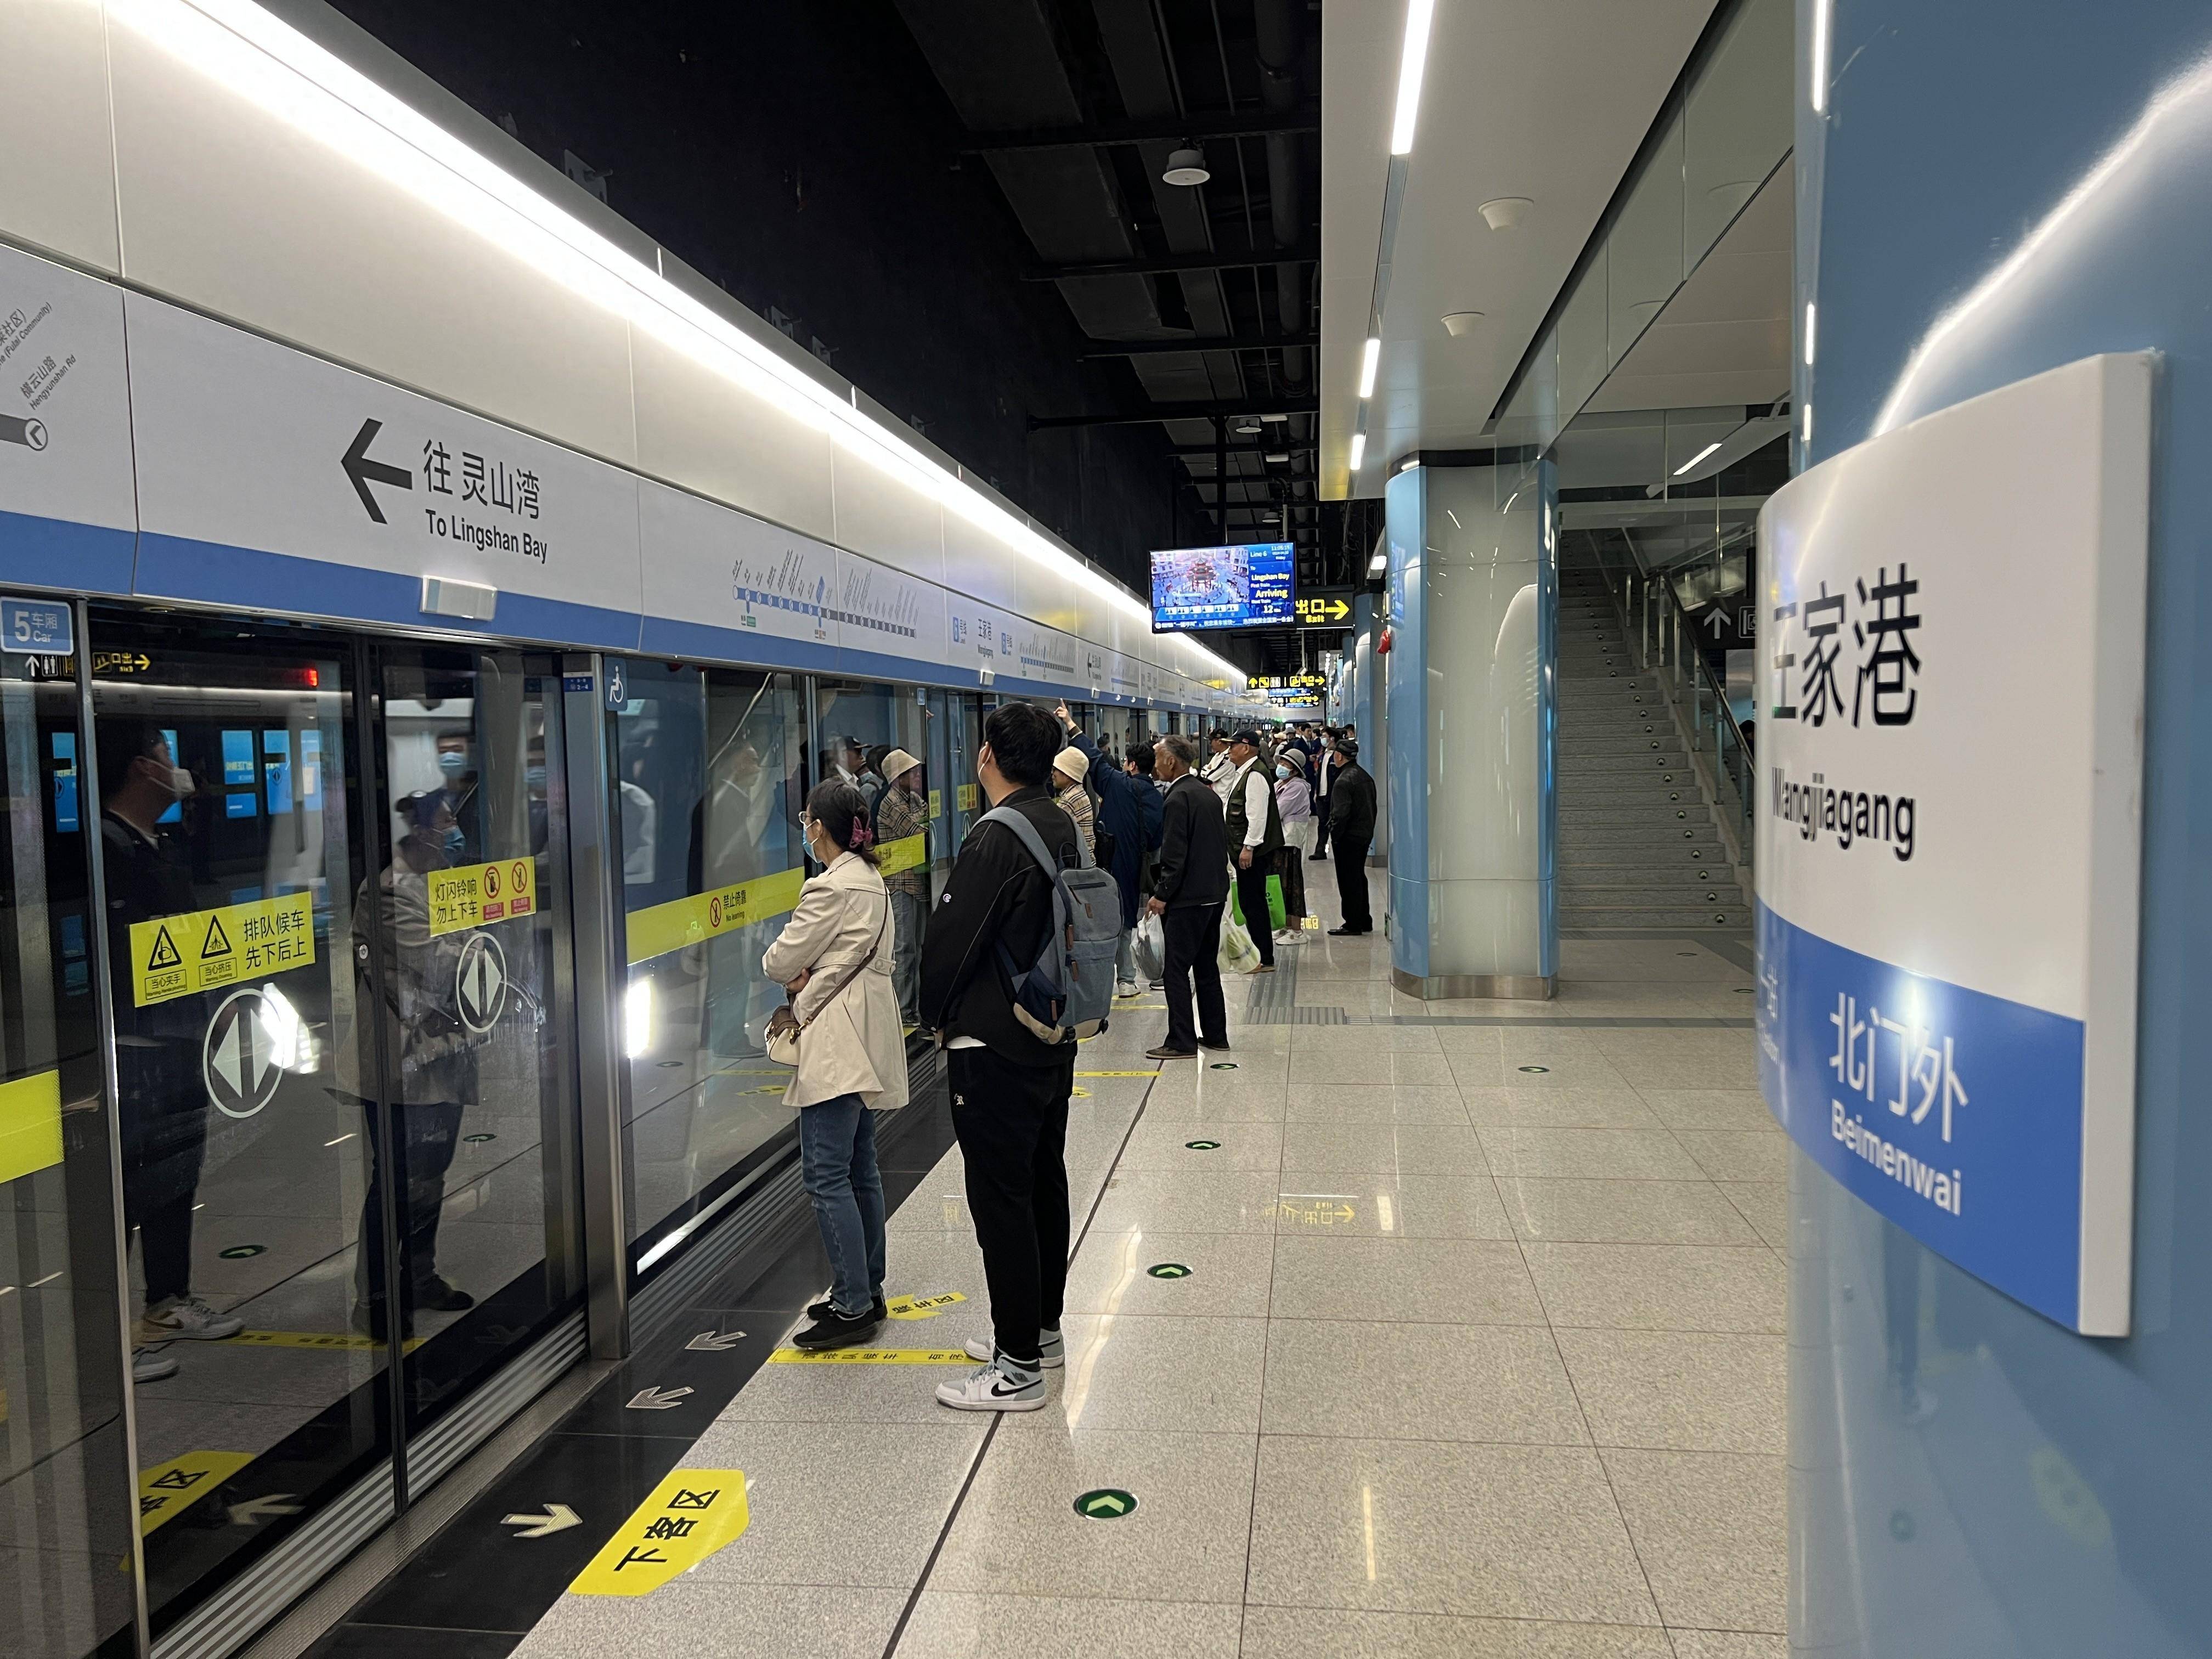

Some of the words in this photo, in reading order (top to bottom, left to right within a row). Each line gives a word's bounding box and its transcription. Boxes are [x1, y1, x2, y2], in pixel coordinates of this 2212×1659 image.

[30, 365, 69, 410] Hengyunshan
[65, 354, 76, 368] Rd
[423, 438, 540, 520] 往灵山湾
[425, 509, 447, 537] To
[452, 515, 519, 552] Lingshan
[523, 532, 548, 565] Bay
[1255, 589, 1288, 599] Arriving
[1295, 599, 1325, 614] 出口
[31, 612, 58, 630] 车厢
[1263, 605, 1273, 613] 12
[1306, 614, 1325, 623] Exit
[15, 610, 31, 642] 5
[33, 630, 52, 643] Car
[1772, 563, 1922, 729] 王家港
[1771, 767, 1916, 862] Wangjiagang
[435, 878, 477, 902] 灯闪铃响
[723, 889, 747, 910] 禁止倚靠
[437, 899, 478, 926] 勿上下车
[726, 913, 731, 922] No
[244, 909, 305, 942] 排队候车
[246, 935, 307, 970] 先下后上
[151, 973, 182, 989] 当心夹手
[205, 961, 232, 977] 当心挤压
[1829, 992, 1970, 1143] 北门外
[1831, 1098, 1961, 1217] Beimenwai
[891, 1295, 955, 1314] 候车区
[613, 1488, 721, 1572] 下客区
